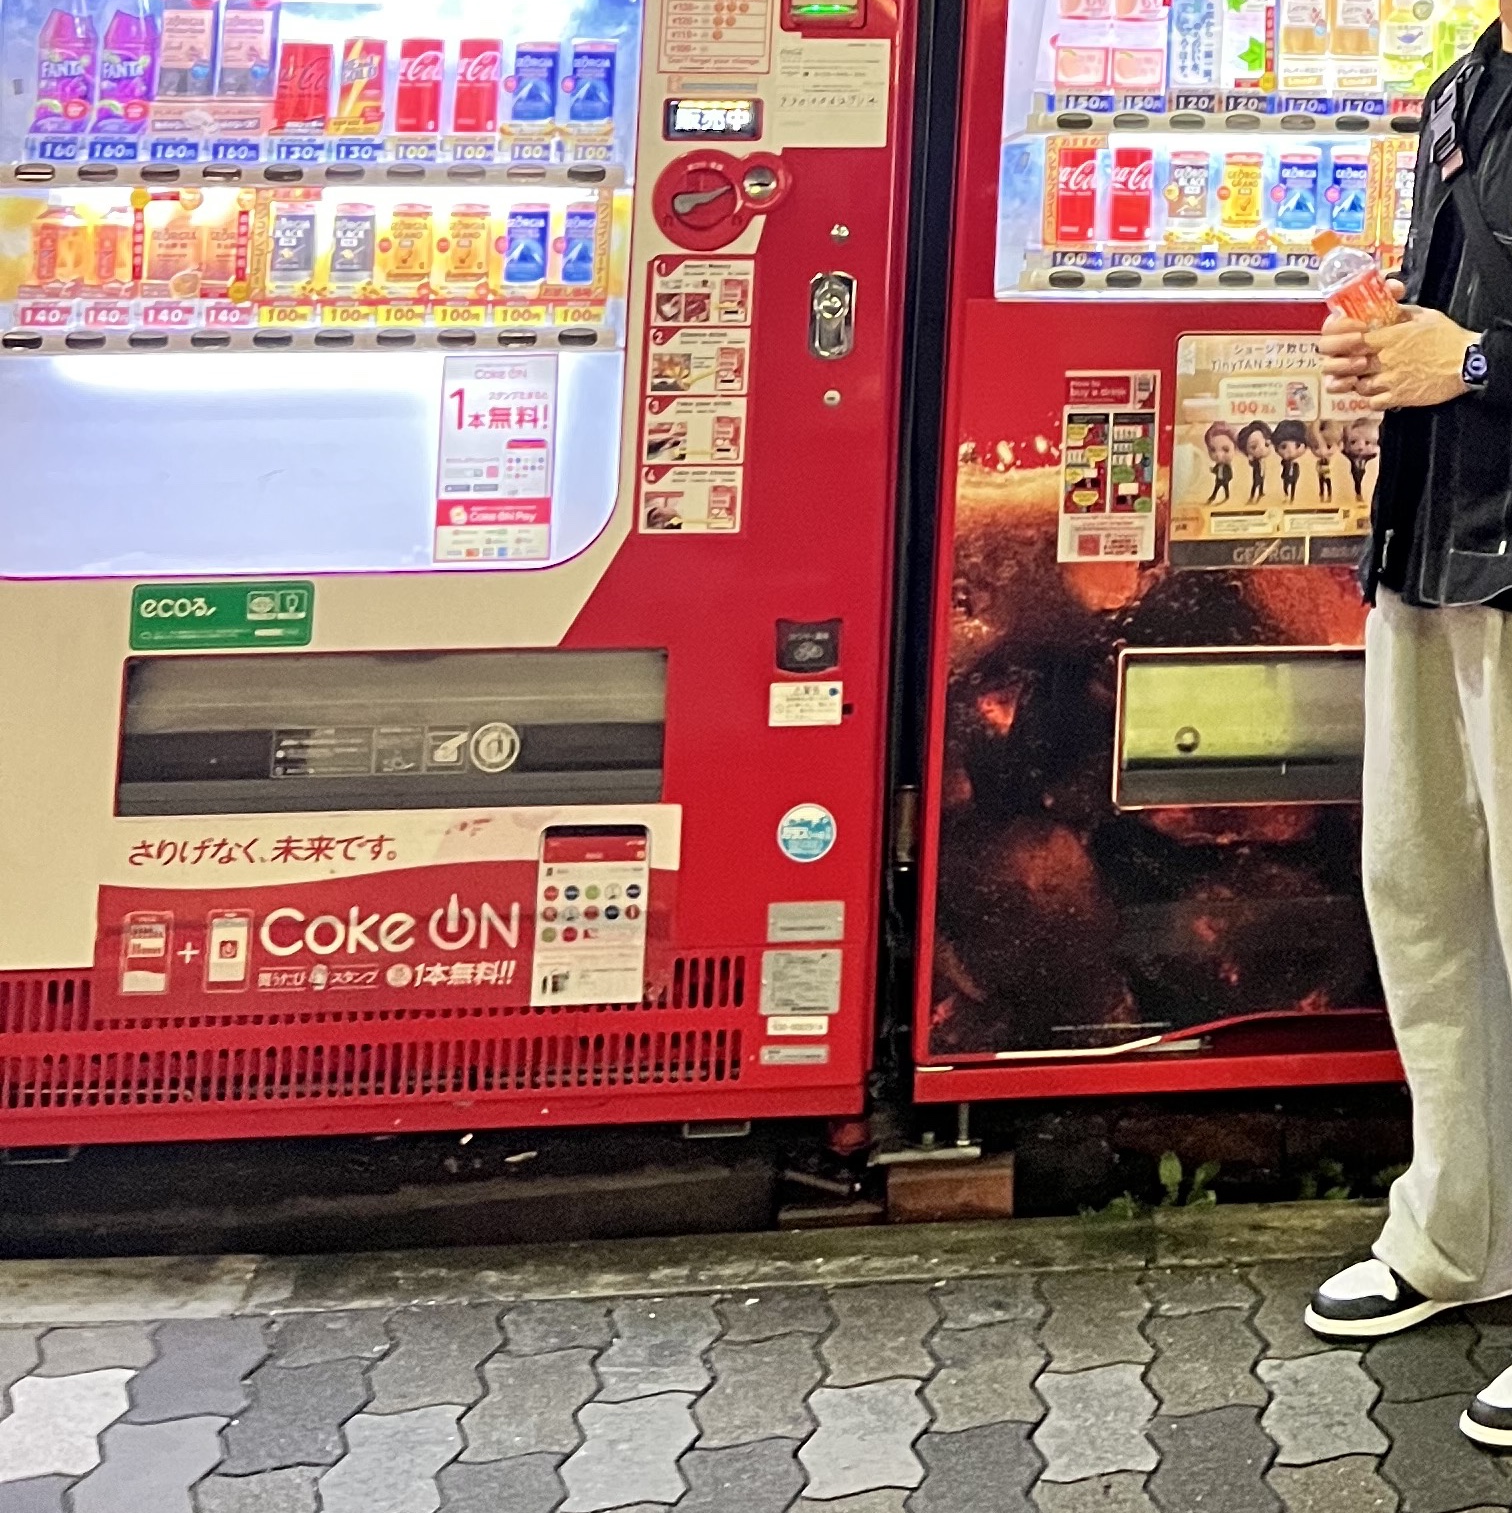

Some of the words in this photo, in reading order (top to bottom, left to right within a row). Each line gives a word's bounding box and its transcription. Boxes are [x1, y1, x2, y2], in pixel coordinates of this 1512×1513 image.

[127, 834, 400, 868] さりげなく、未来です。
[258, 904, 416, 957] Coke
[428, 892, 521, 952] ON
